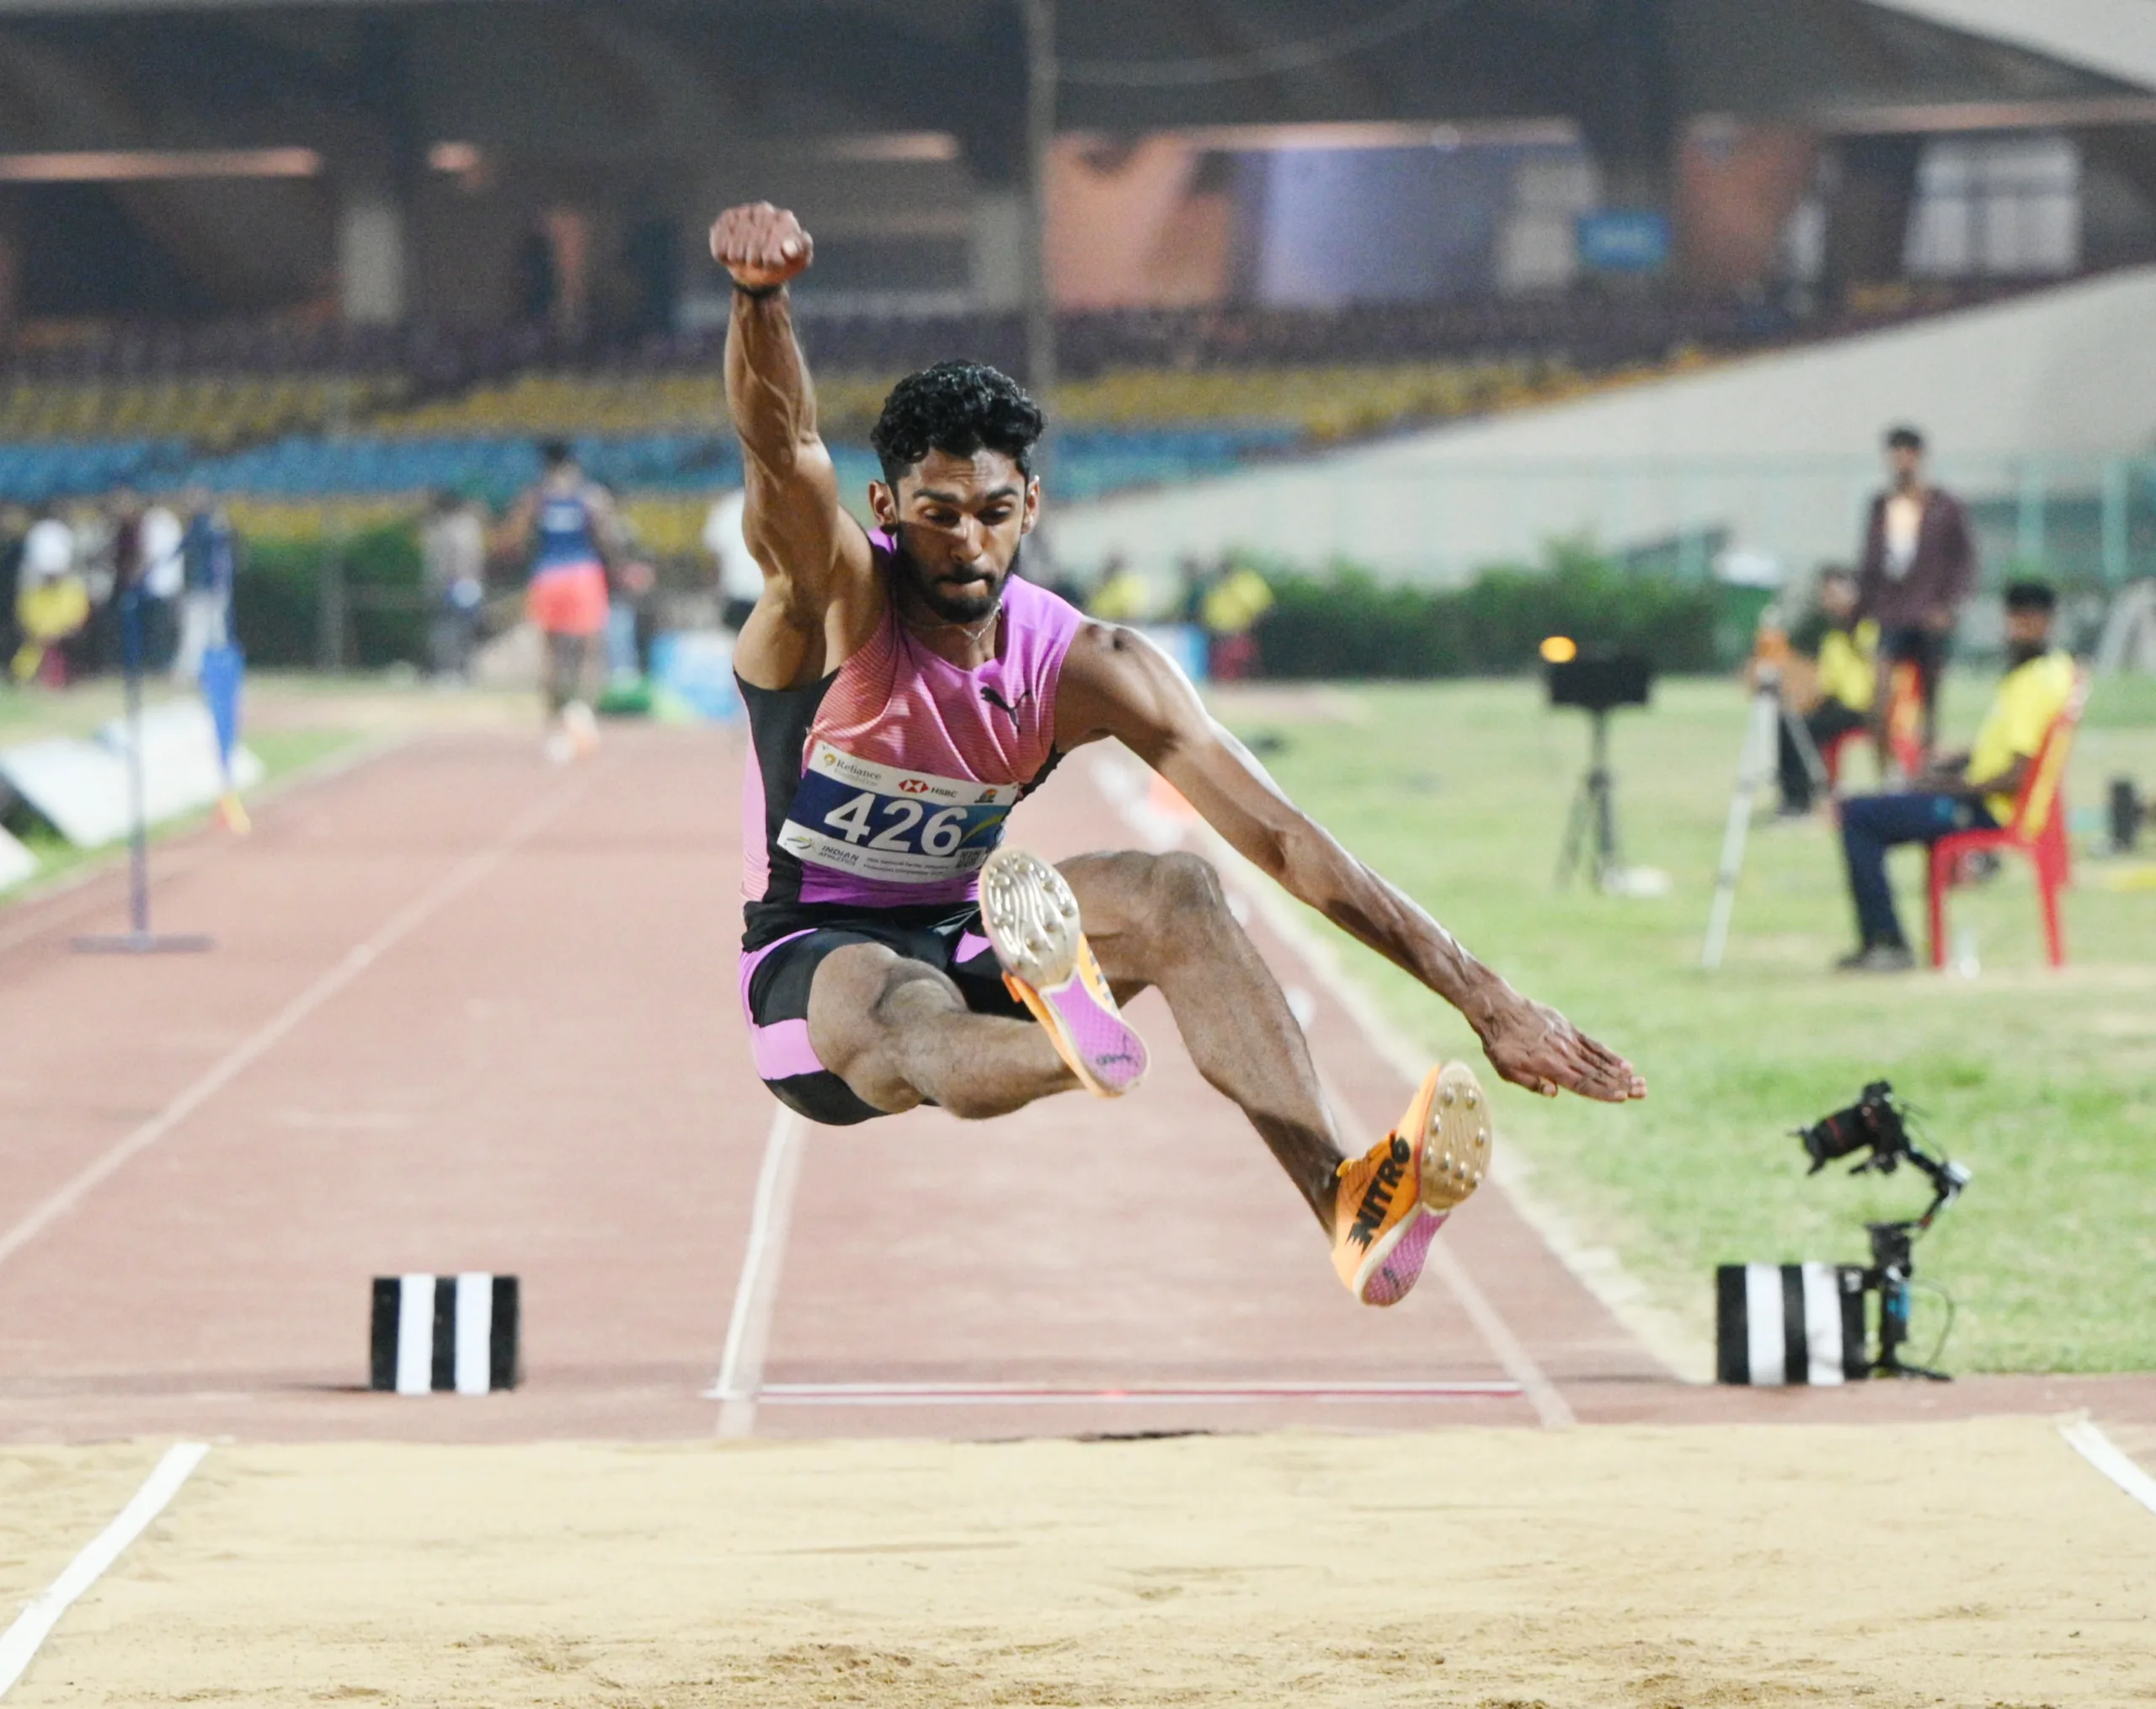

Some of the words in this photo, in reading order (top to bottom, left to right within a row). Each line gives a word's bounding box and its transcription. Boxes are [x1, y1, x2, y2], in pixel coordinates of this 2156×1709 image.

[836, 759, 882, 780] Reliance
[931, 786, 958, 798] HSBC
[825, 793, 969, 857] 426
[821, 845, 860, 861] INDIAN
[1346, 1136, 1411, 1258] NITRO
